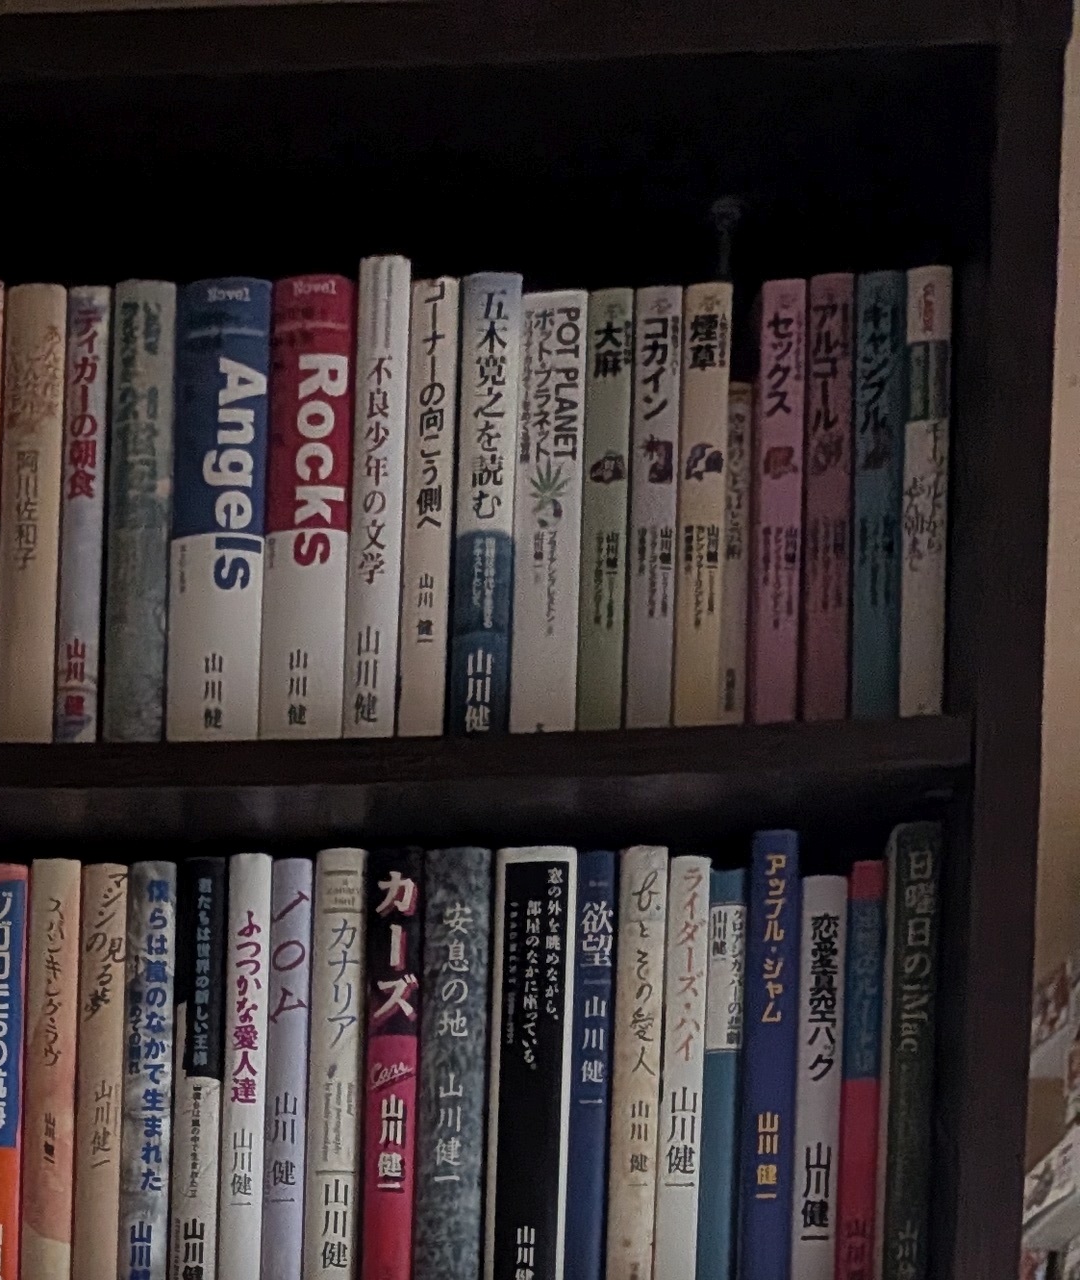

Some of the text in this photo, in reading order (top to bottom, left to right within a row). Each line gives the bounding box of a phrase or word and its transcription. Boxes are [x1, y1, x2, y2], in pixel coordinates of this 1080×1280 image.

[558, 307, 580, 346] POT
[593, 323, 622, 376] 大麻
[641, 318, 667, 421] コカイン
[689, 314, 717, 370] 煙草
[767, 316, 796, 416] セックス
[472, 292, 507, 520] 五木寛之を読む
[203, 356, 266, 590] Angels
[358, 356, 392, 585] 不良少年の文学
[325, 919, 359, 1048] カナリア
[372, 870, 418, 1021] カーズ
[437, 904, 471, 1038] 安息の地
[579, 902, 612, 968] 欲望
[674, 869, 706, 1062] ライダーズ・ハイ
[230, 910, 263, 1104] ふつつかな愛人達
[809, 913, 839, 1082] 恋愛真空パック
[230, 1129, 253, 1207] 山川健一
[271, 1092, 298, 1202] 山川健一
[627, 1101, 649, 1186] 山川健一
